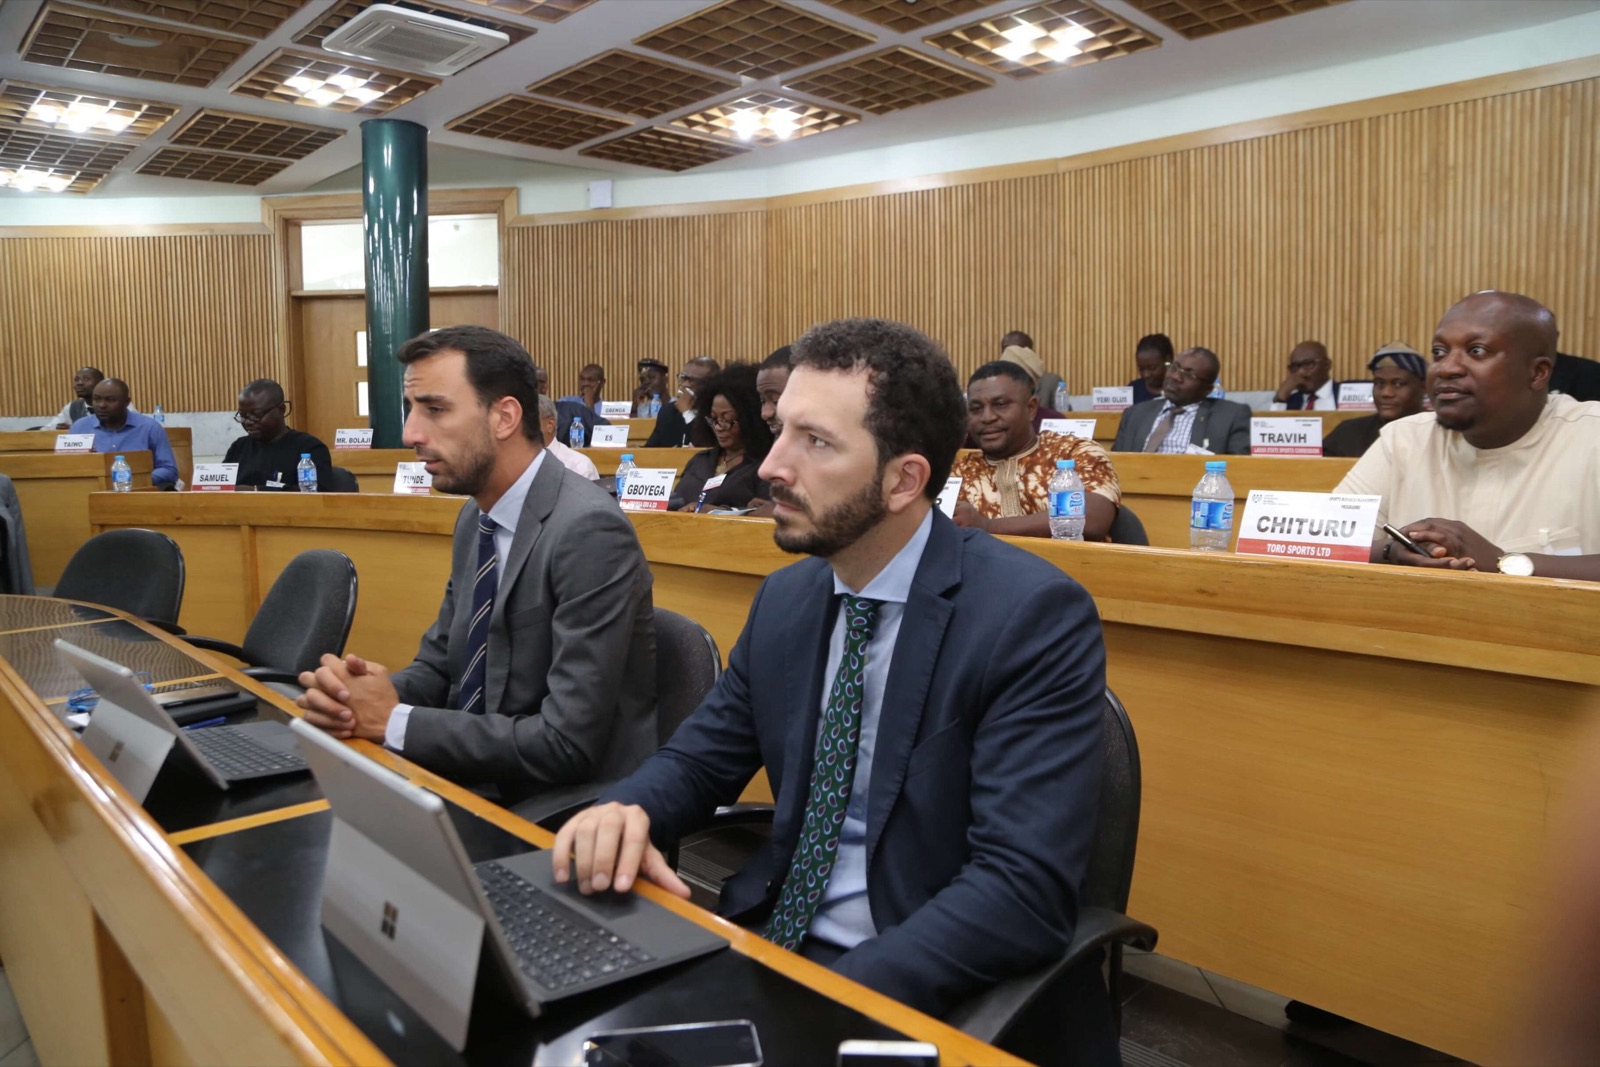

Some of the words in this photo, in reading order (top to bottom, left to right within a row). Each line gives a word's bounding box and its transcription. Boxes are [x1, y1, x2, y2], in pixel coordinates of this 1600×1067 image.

[1259, 433, 1307, 444] TRAVIH
[199, 474, 229, 482] SAMUEL
[627, 484, 665, 496] GBOYEGA
[1256, 515, 1357, 539] CHITURU
[1266, 543, 1286, 554] TORO
[1287, 545, 1315, 556] SPORTS
[1316, 547, 1331, 557] LTD
